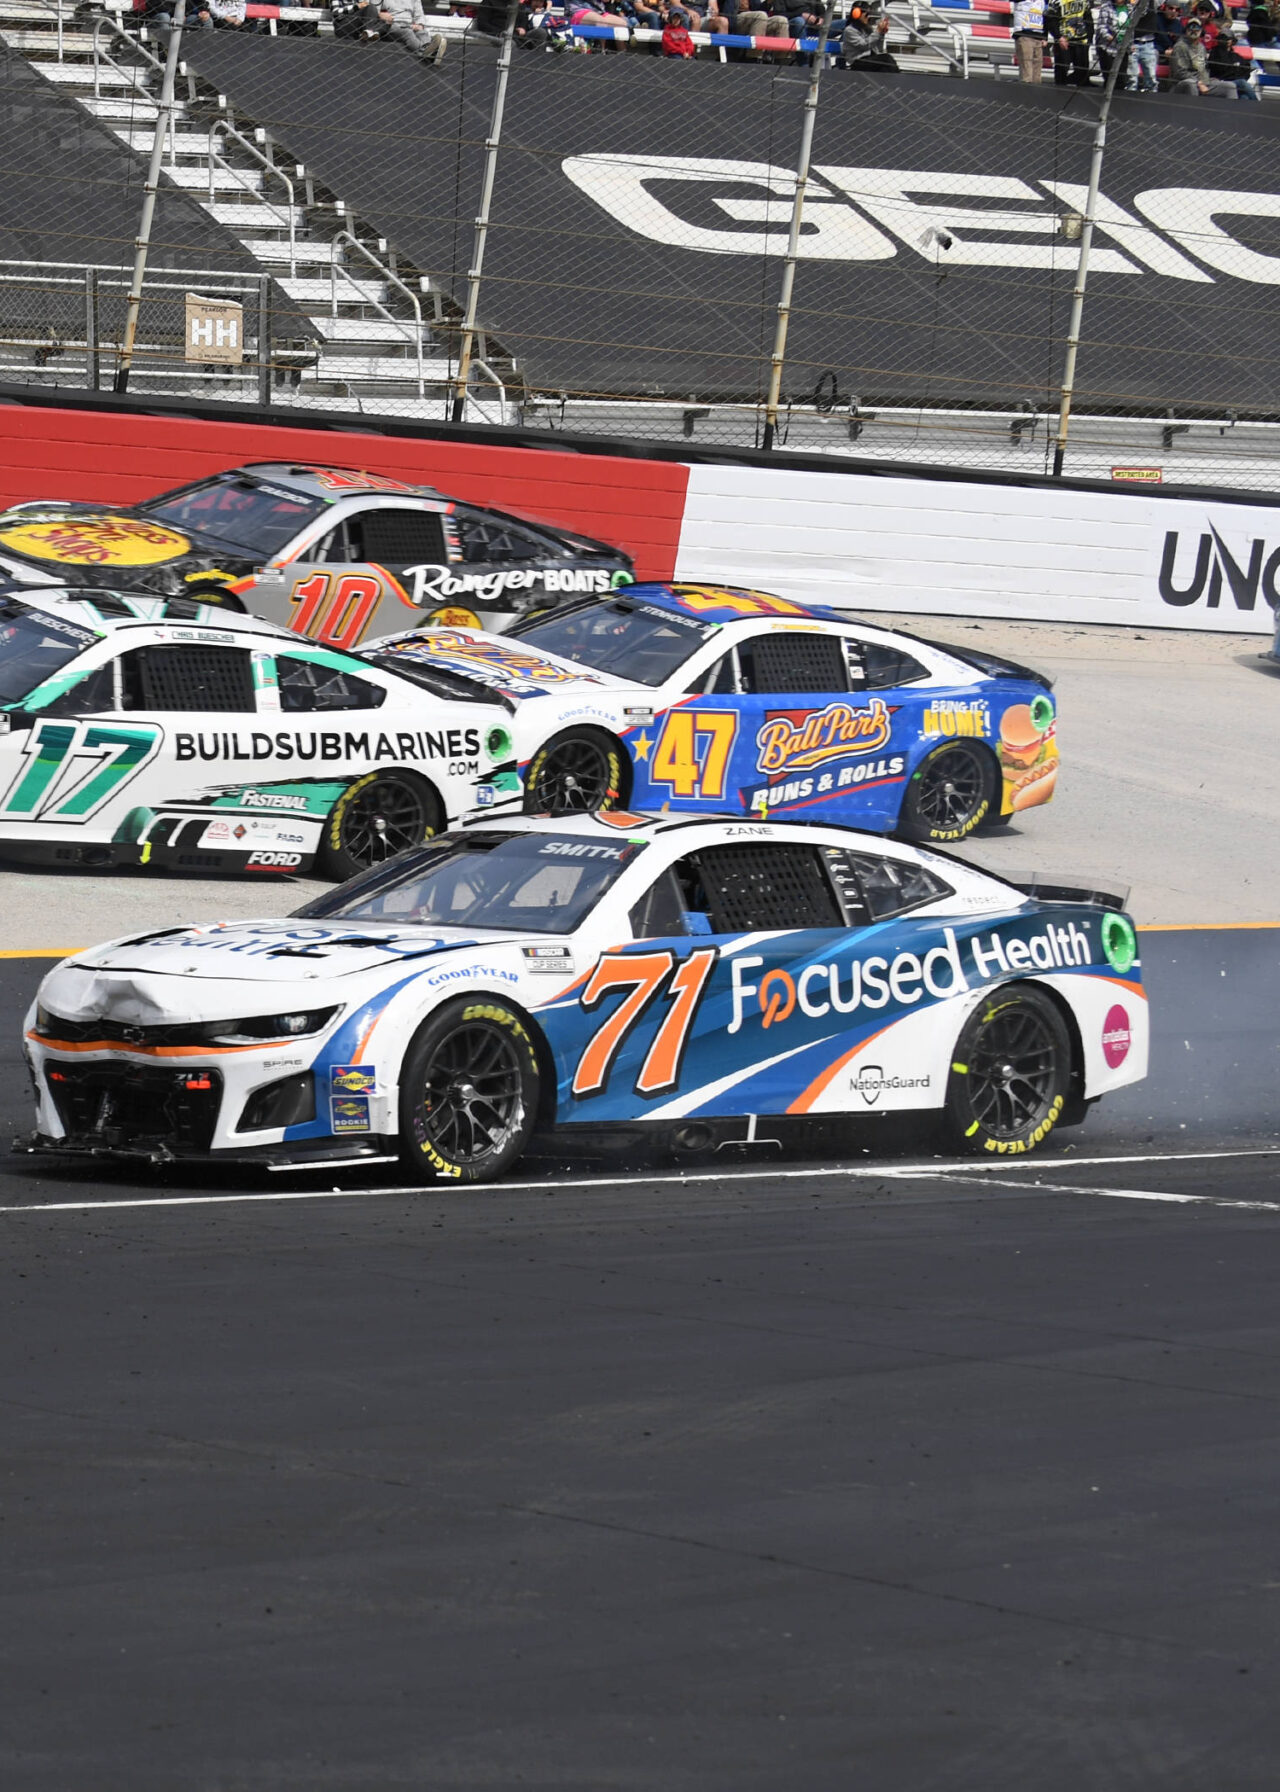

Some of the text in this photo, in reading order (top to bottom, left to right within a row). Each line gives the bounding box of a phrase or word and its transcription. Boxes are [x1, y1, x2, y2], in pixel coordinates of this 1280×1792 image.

[191, 318, 237, 347] HH
[402, 564, 610, 605] Ranger BOATS
[286, 571, 386, 650] 10
[639, 605, 701, 630] STENHOUSE
[930, 700, 968, 714] BRING
[761, 701, 887, 769] Ball Park
[923, 709, 991, 738] HOME!
[175, 729, 481, 762] BUILDSUBMARINES
[648, 708, 740, 800] 47
[446, 761, 479, 776] .COM
[750, 757, 905, 811] BUNS & ROLLS
[239, 789, 309, 810] FASTENAL
[723, 827, 775, 837] ZANE
[929, 799, 989, 839] GOODYEAR
[247, 851, 303, 867] FORD
[538, 842, 625, 861] SMITH
[428, 965, 519, 987] GOODYEAR
[727, 920, 1093, 1035] Focused Health
[570, 945, 720, 1100] 71
[262, 1057, 303, 1069] SPIRE
[333, 1076, 376, 1086] SUNOCO
[849, 1075, 930, 1091] NationsGuard
[984, 1095, 1064, 1154] GOODYEAR
[420, 1140, 462, 1177] EAGLE
